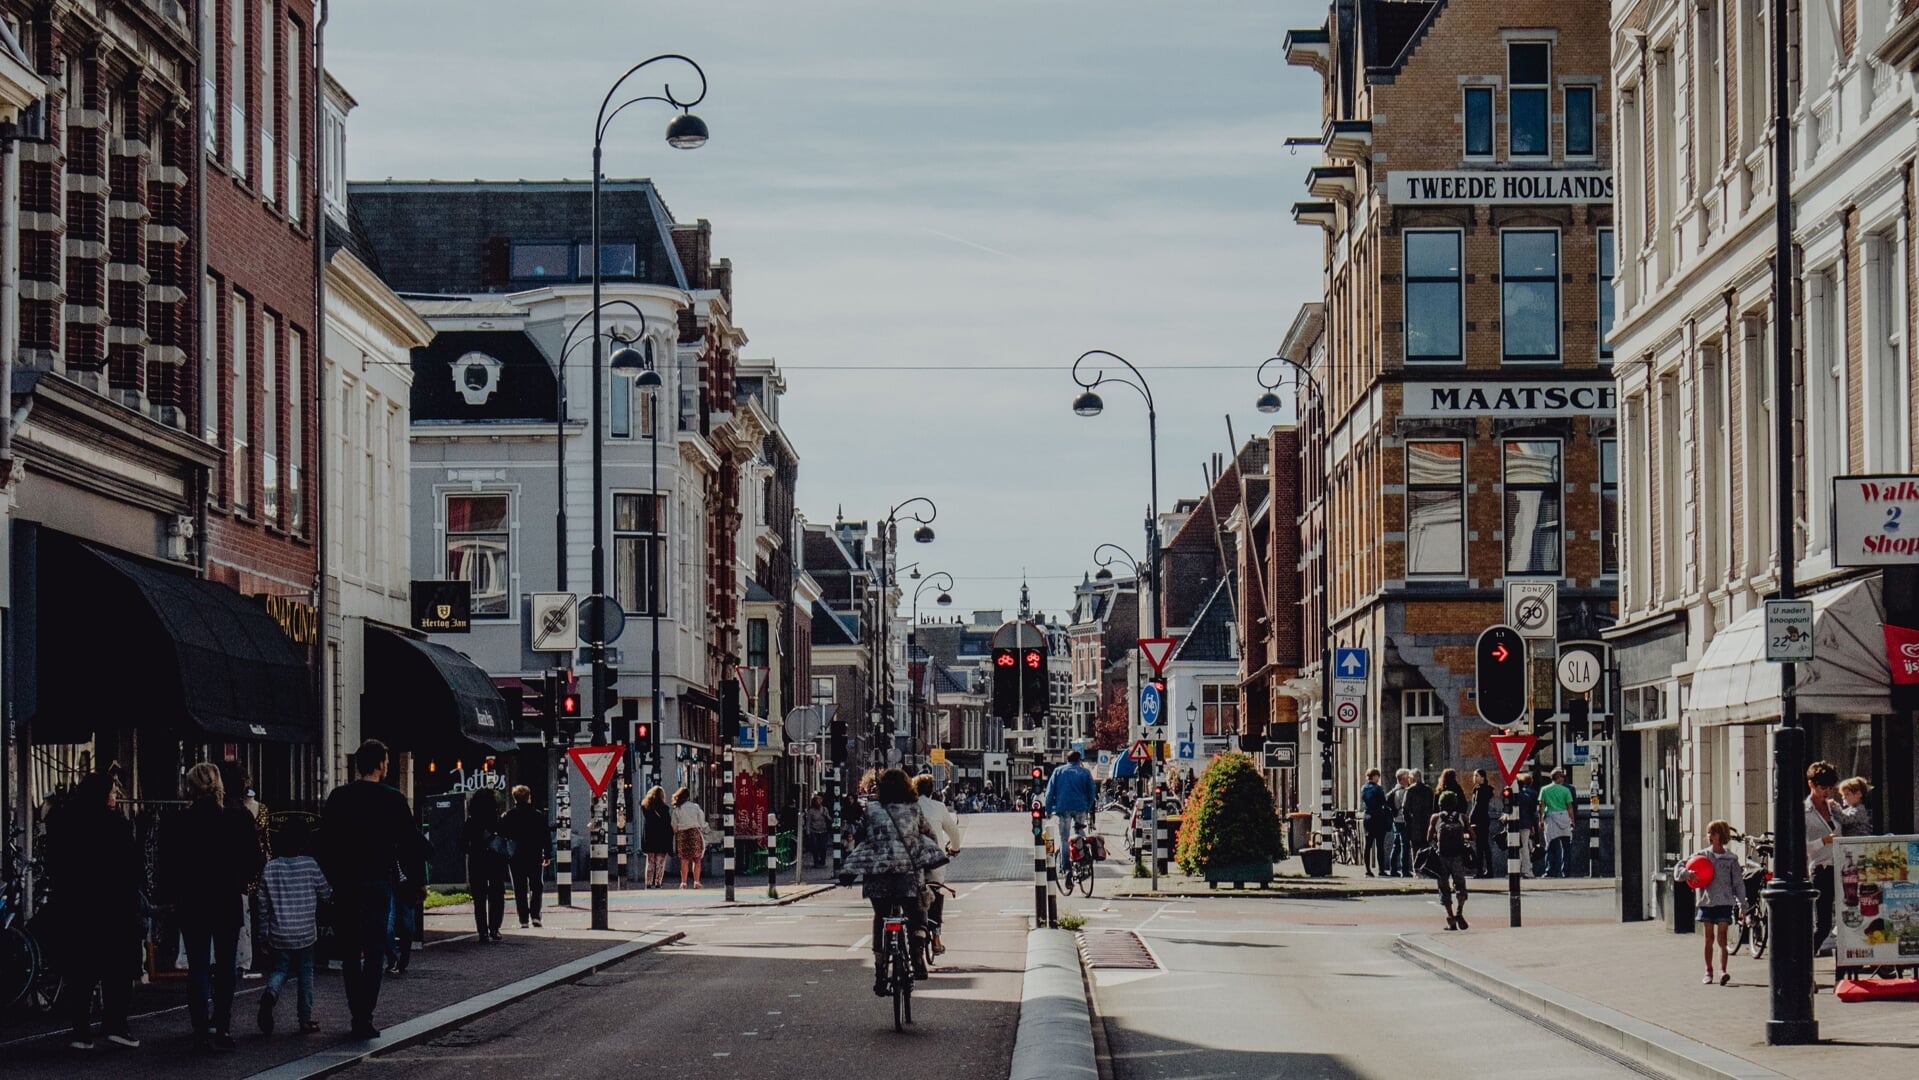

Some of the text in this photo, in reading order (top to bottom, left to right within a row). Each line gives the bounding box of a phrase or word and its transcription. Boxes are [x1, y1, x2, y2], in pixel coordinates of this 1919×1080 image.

[1406, 176, 1614, 199] TWEEDE HOLLANDS
[1430, 387, 1617, 410] MAATSCH
[1860, 481, 1919, 502] Walk
[1882, 506, 1902, 530] 2
[1522, 606, 1542, 619] 30
[1769, 616, 1810, 624] knooppunt
[420, 617, 467, 629] Hertog Jan
[1772, 636, 1788, 648] 22
[1568, 660, 1590, 683] SLA
[1903, 659, 1919, 675] ijs
[1341, 708, 1354, 717] 30
[449, 768, 506, 794] Jettes
